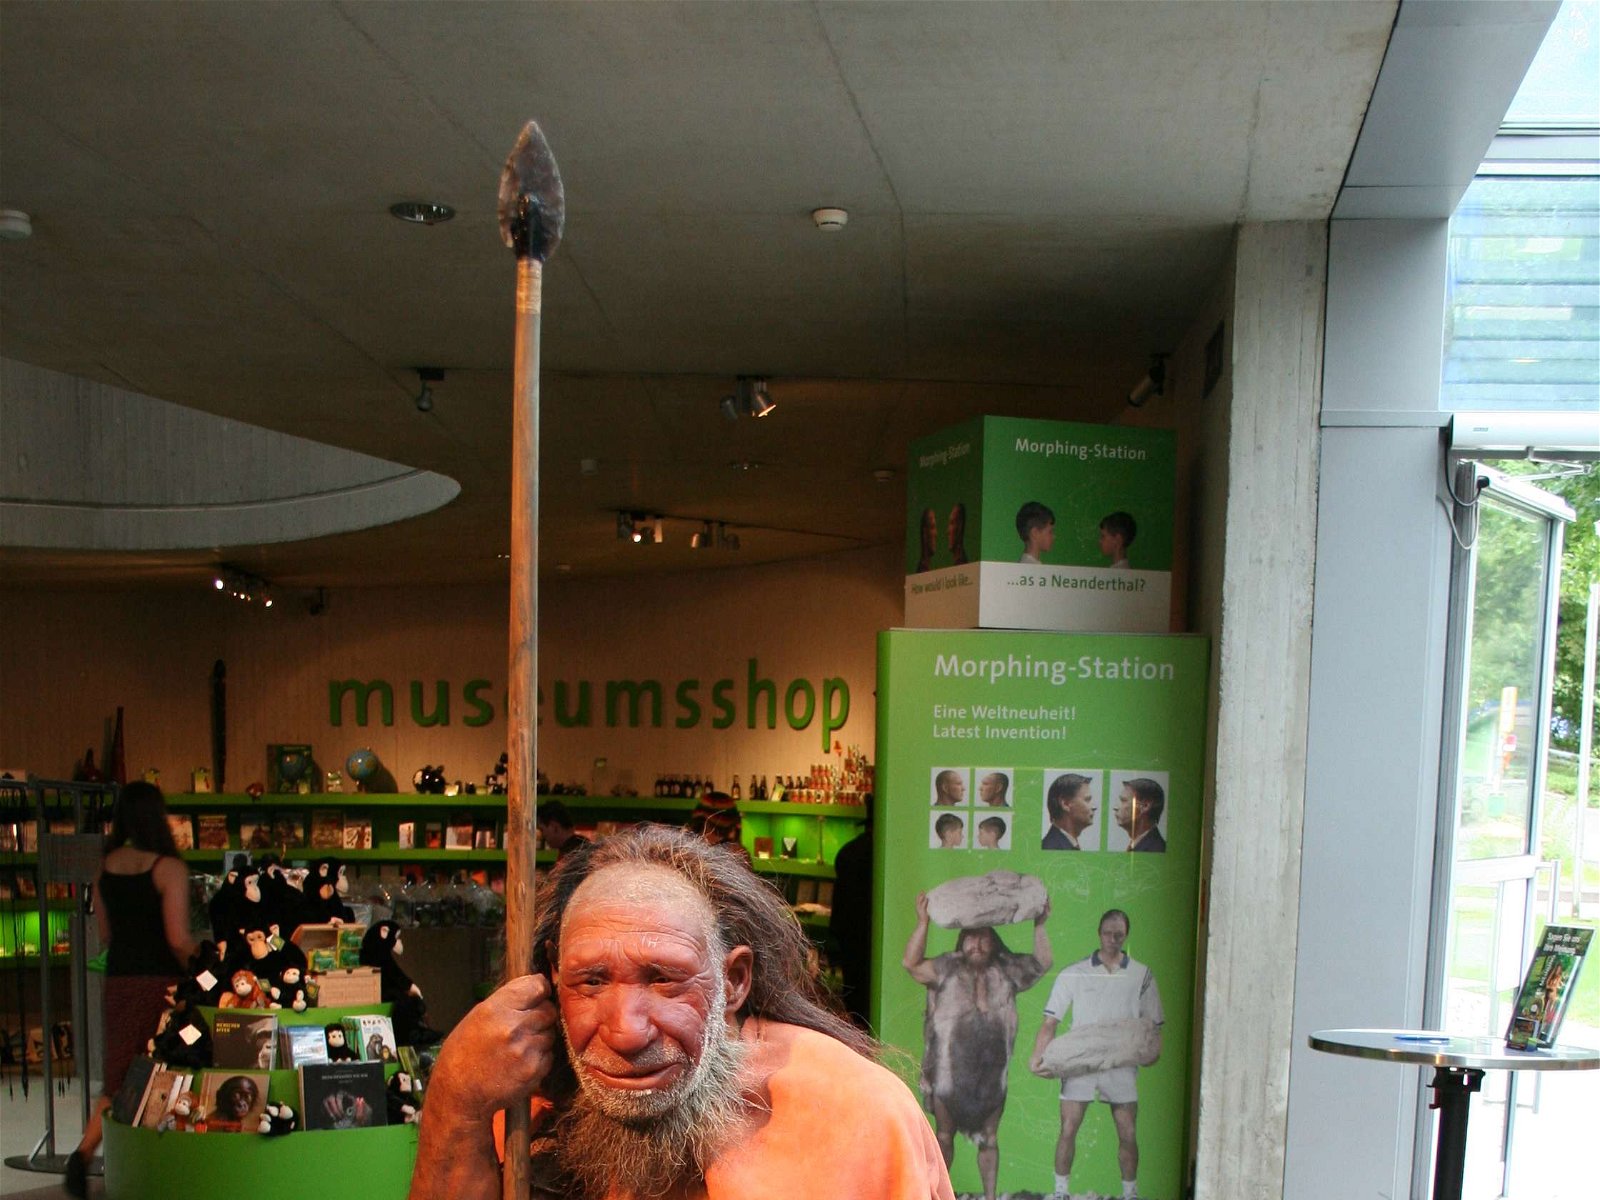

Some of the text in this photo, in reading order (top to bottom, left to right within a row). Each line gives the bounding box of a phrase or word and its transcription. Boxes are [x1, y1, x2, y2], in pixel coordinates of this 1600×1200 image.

[1016, 438, 1146, 460] Morphing-Station
[1007, 575, 1146, 592] ...as a Neanderthal?
[933, 654, 1175, 685] Morphing-Station
[328, 657, 851, 753] musumsshop
[933, 705, 1076, 721] Eine Weltneuheit!
[933, 725, 1067, 741] Latest Invention!
